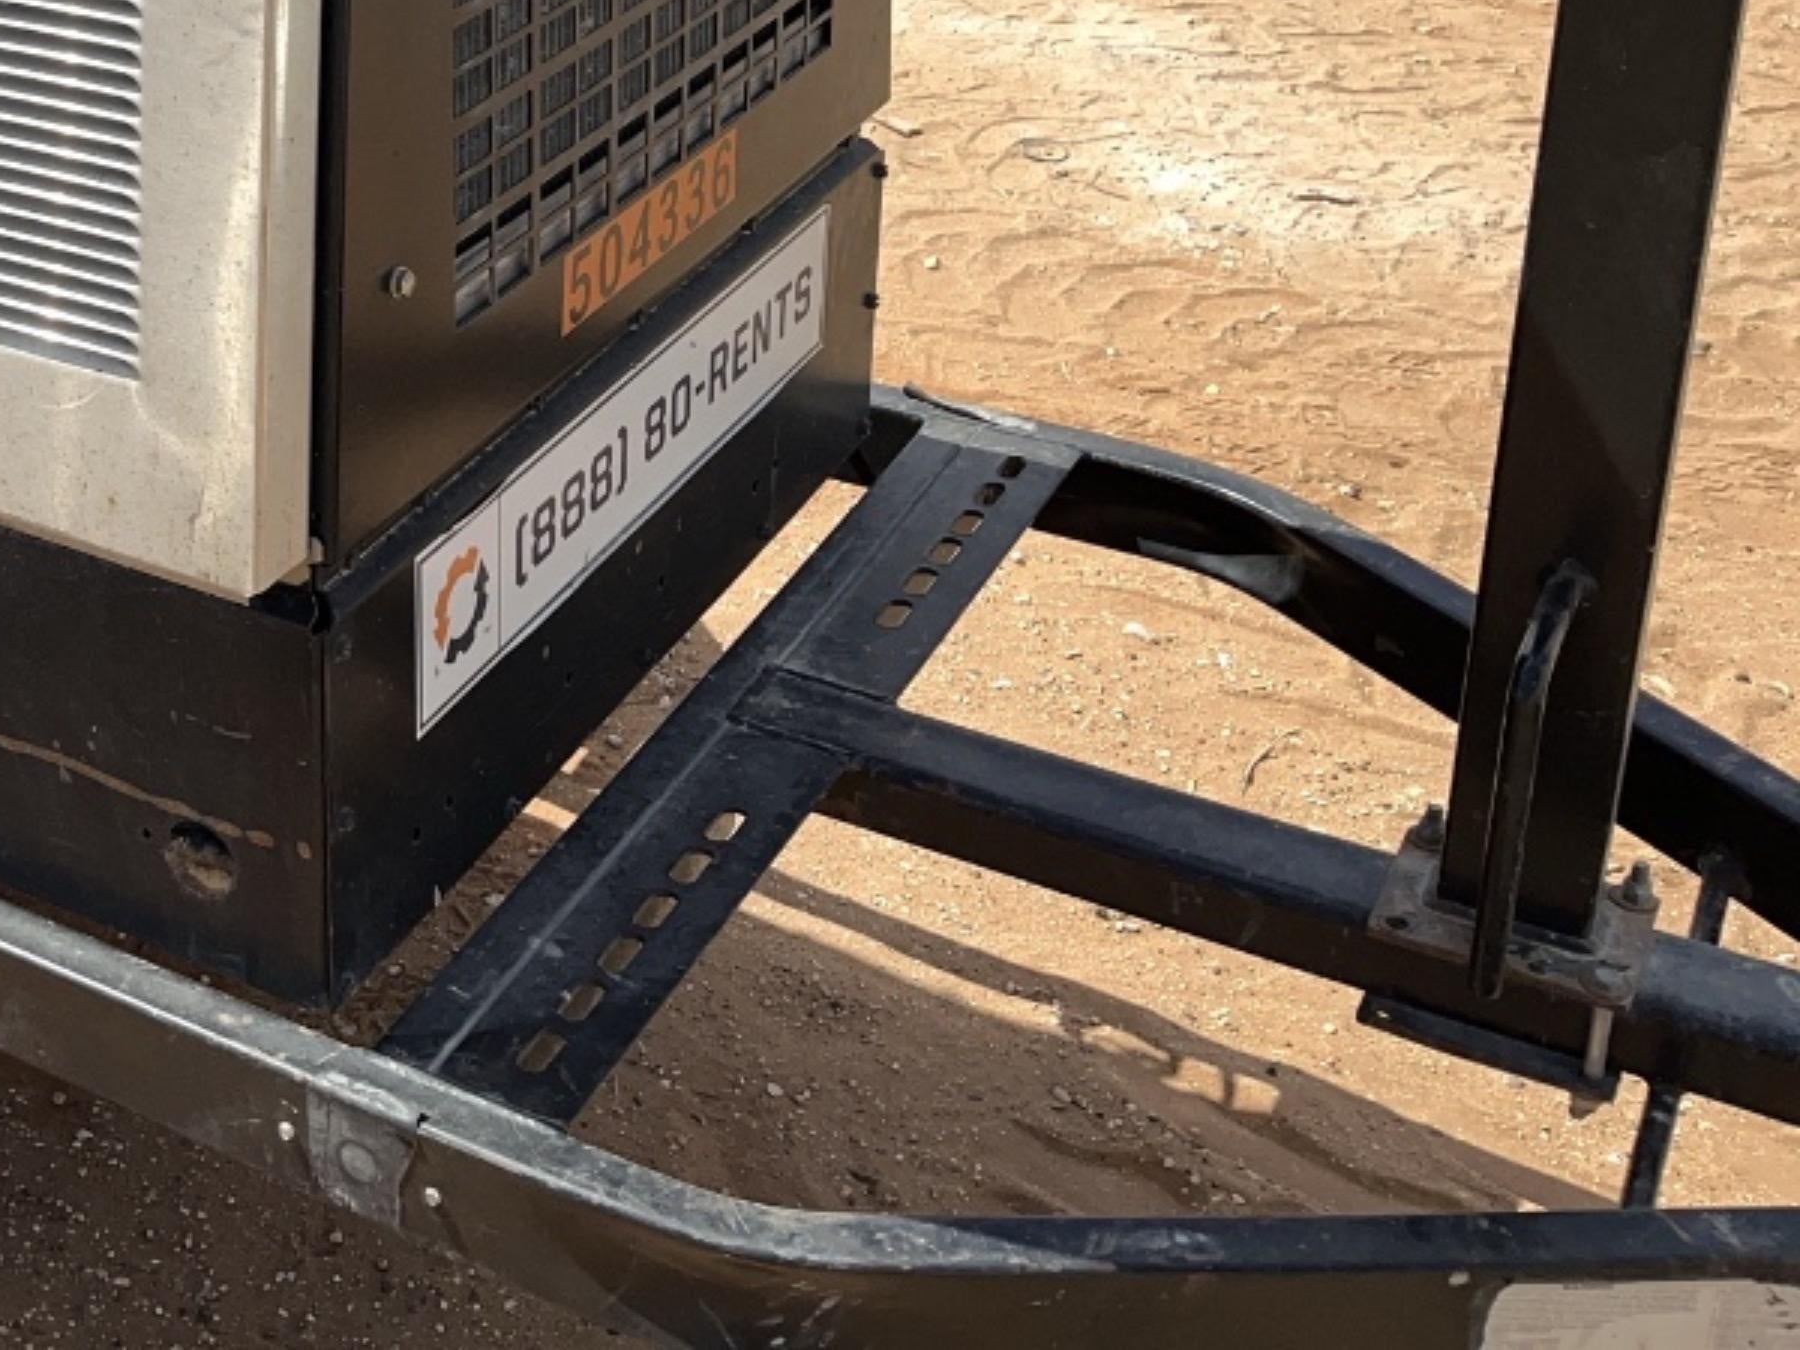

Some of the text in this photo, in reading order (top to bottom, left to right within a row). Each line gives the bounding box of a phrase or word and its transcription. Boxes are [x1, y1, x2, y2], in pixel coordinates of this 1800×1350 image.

[567, 136, 733, 326] 504336
[515, 265, 814, 589] (888) 80-RENTS
